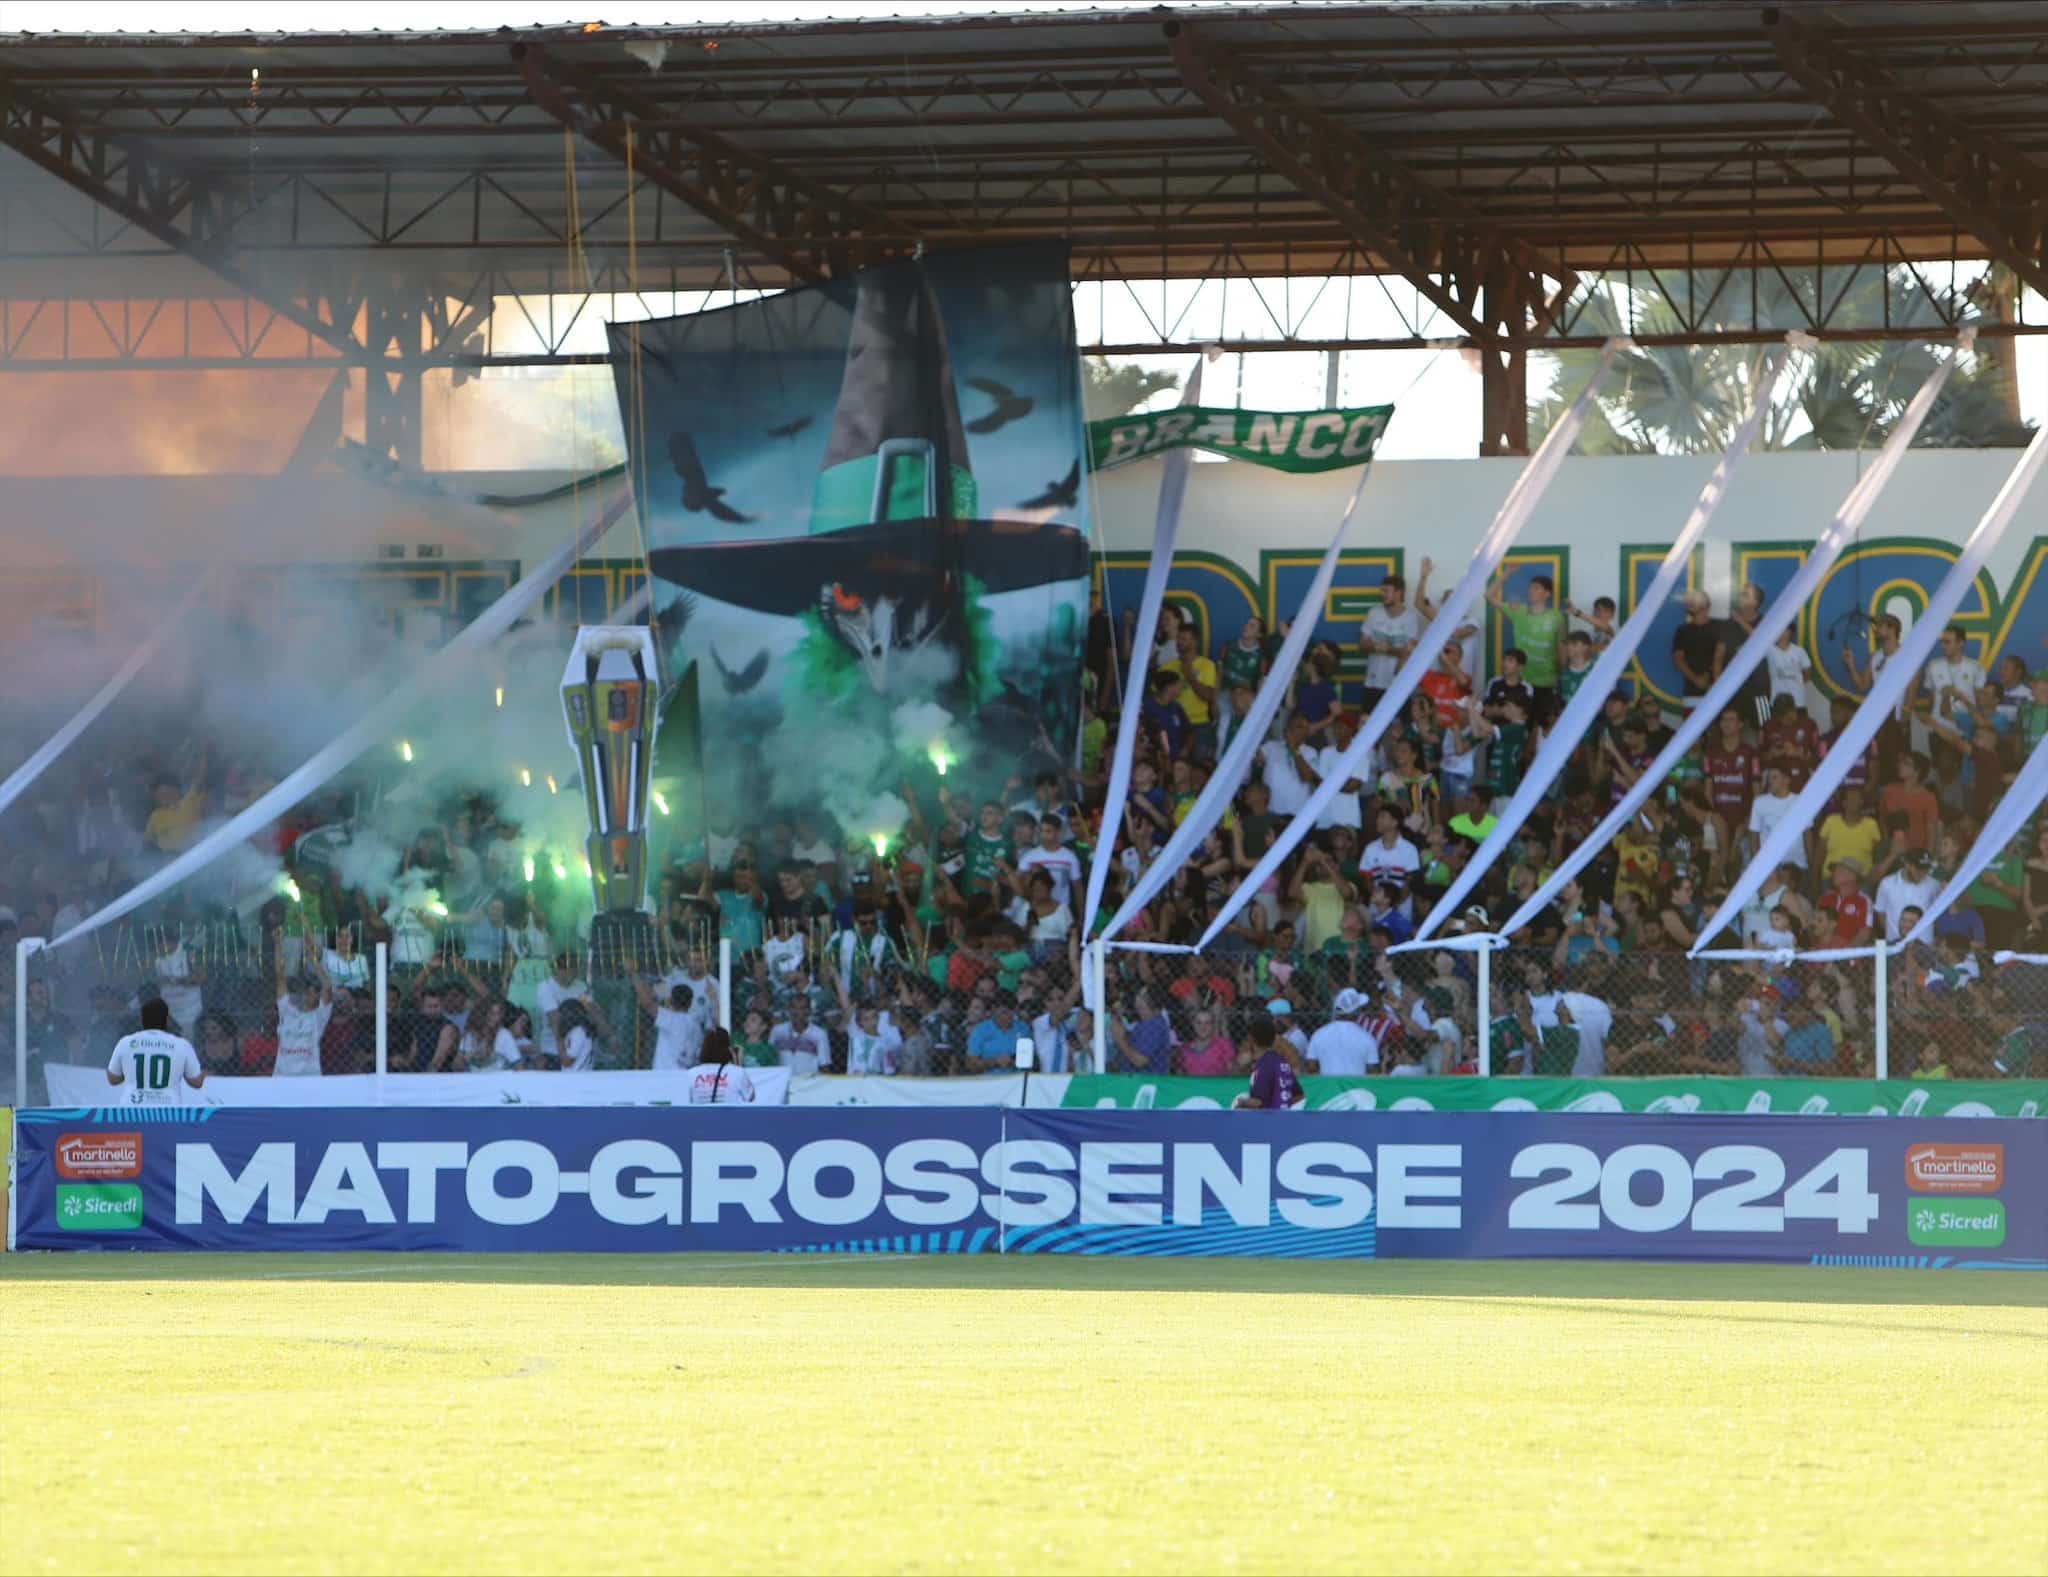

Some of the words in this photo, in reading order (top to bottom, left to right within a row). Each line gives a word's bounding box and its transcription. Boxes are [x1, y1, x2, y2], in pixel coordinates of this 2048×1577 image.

[1106, 411, 1384, 463] BRANCO
[133, 1053, 171, 1089] 10
[72, 1147, 136, 1160] martinello
[1923, 1160, 1997, 1174] martinello
[175, 1139, 1462, 1230] MATO-GROSSENSE
[1508, 1143, 1879, 1233] 2024
[85, 1198, 137, 1213] Sicredi
[1938, 1213, 1999, 1230] Sicredi
